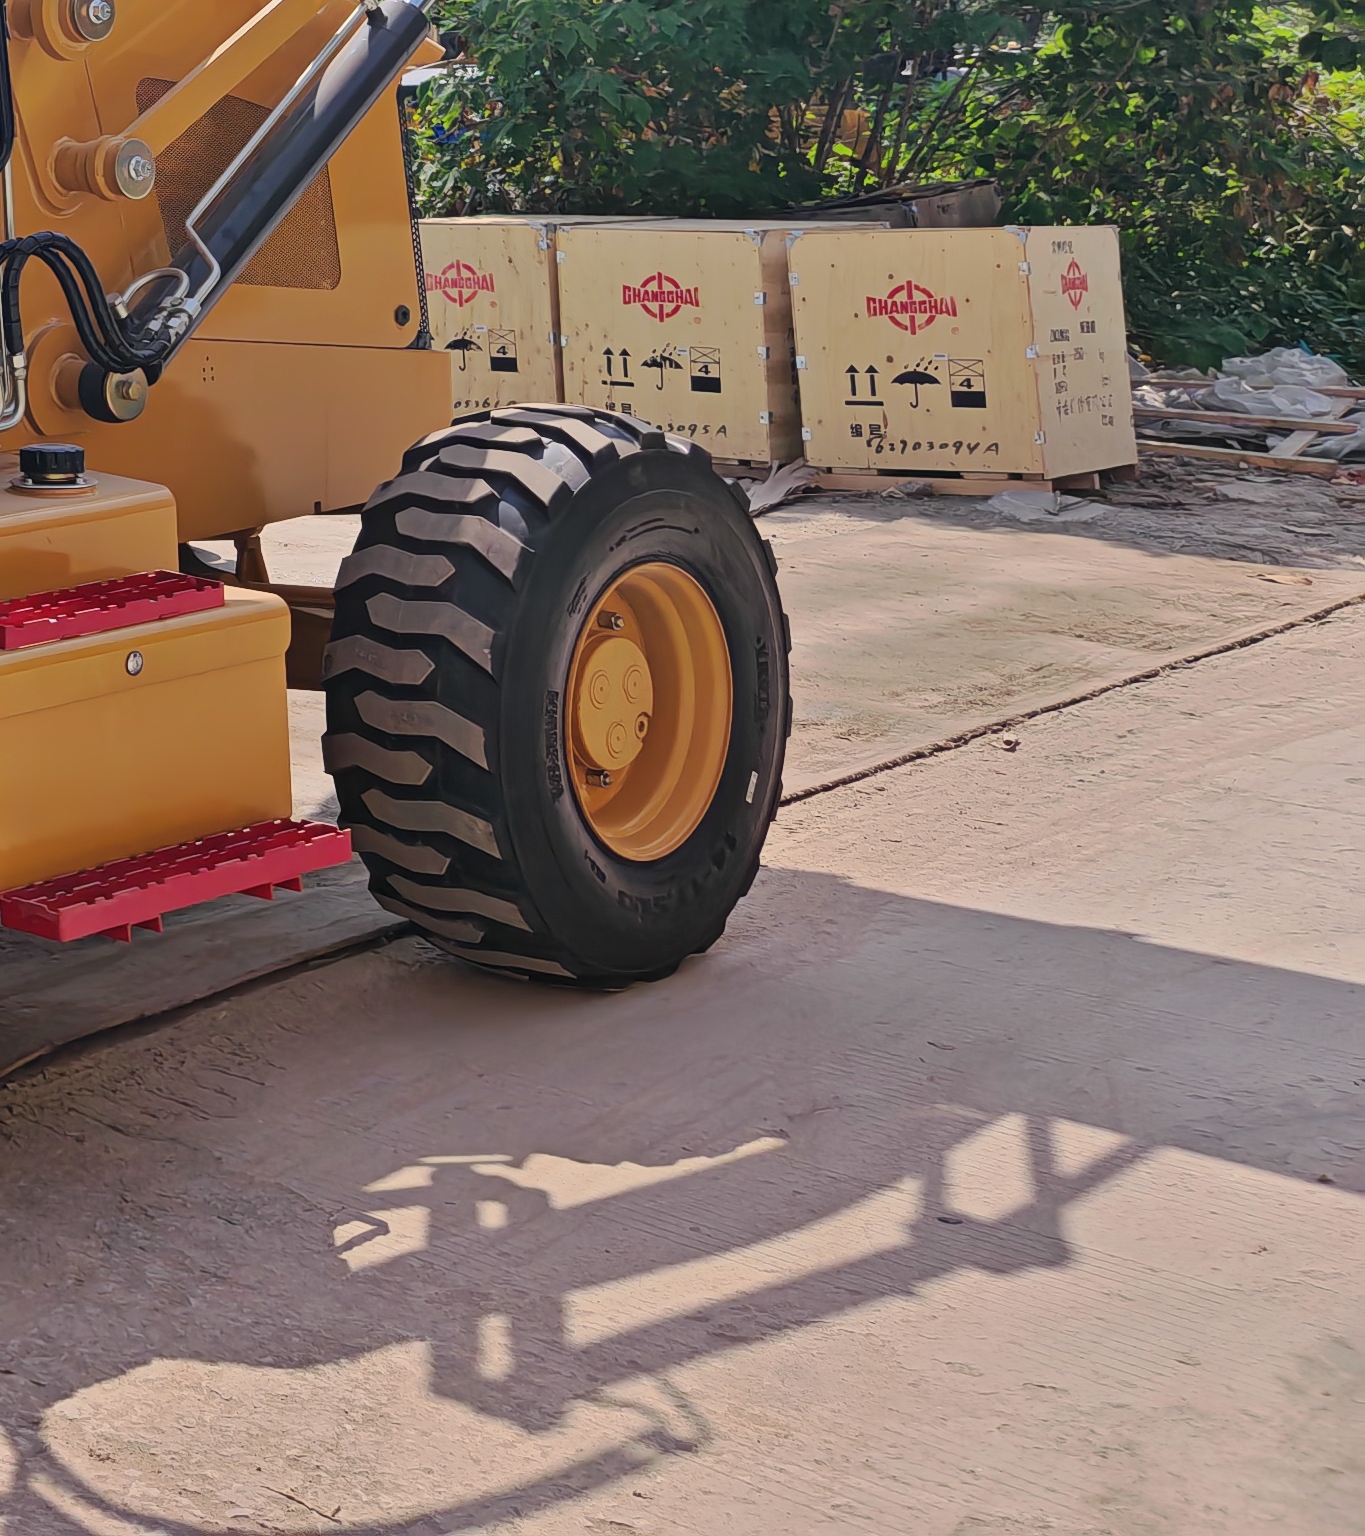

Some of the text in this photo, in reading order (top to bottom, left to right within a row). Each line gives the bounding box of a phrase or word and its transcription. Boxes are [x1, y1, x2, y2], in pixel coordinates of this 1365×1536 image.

[496, 345, 508, 356] 4
[698, 364, 711, 375] 4
[958, 377, 974, 390] 4
